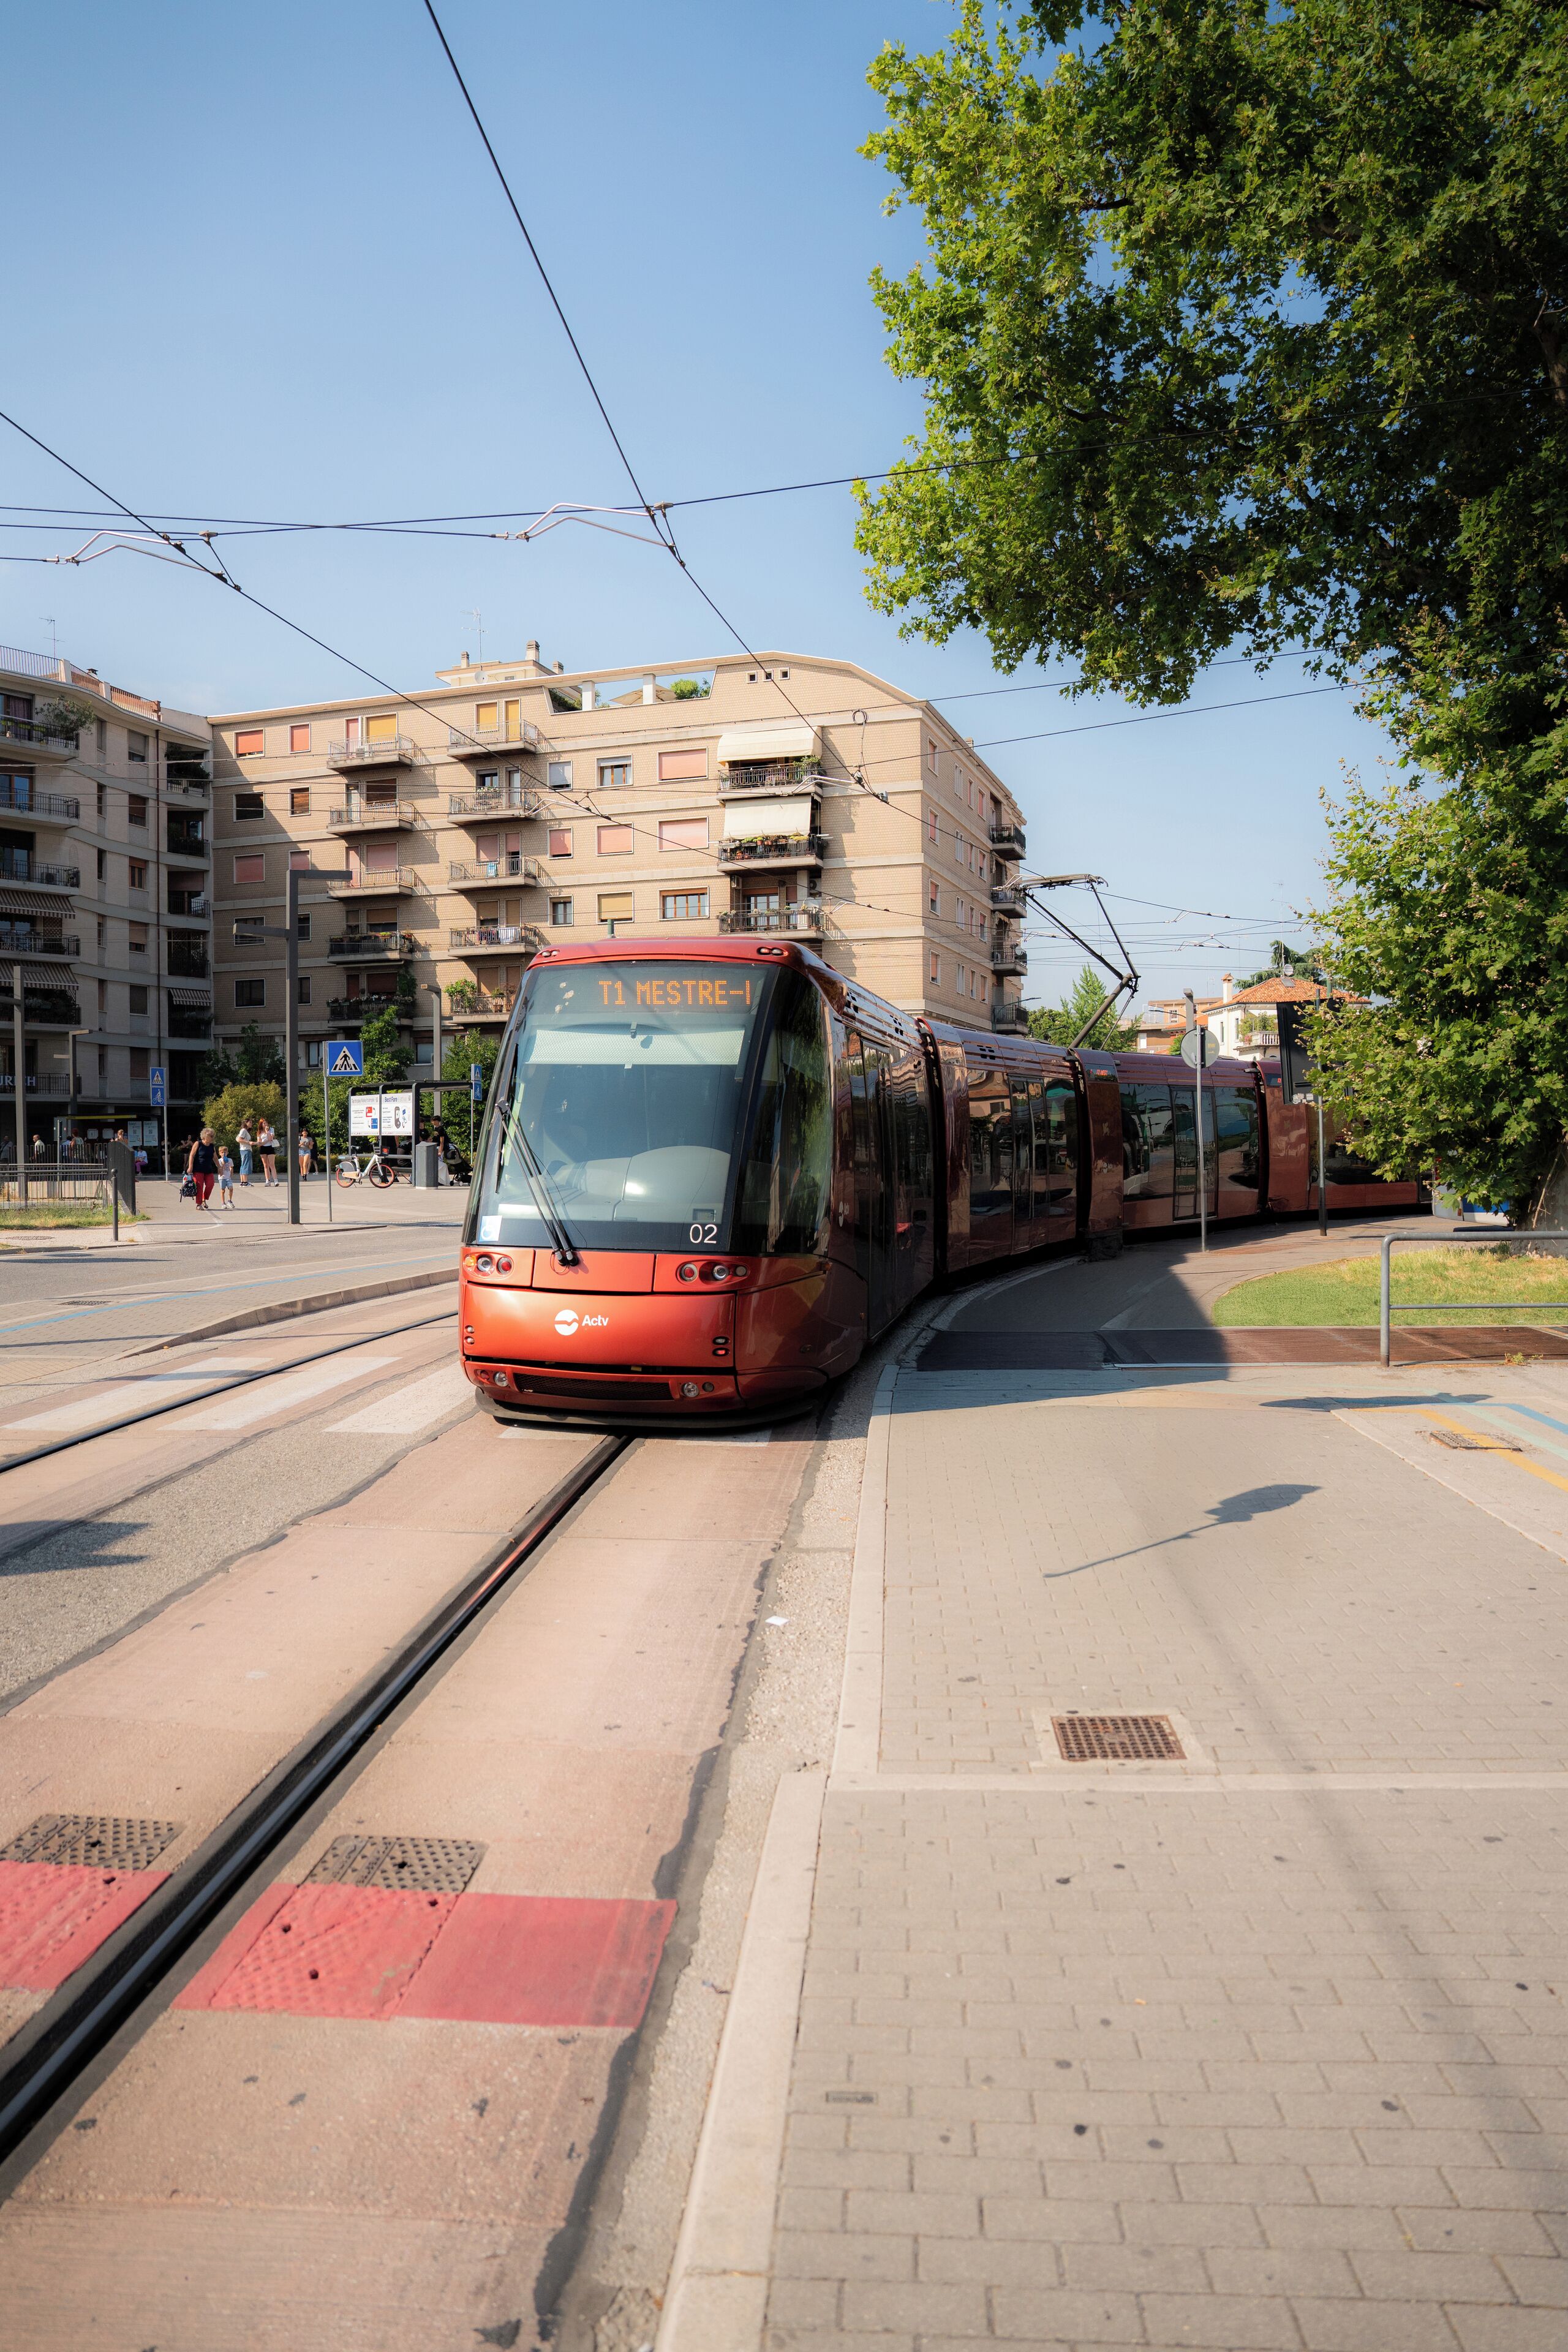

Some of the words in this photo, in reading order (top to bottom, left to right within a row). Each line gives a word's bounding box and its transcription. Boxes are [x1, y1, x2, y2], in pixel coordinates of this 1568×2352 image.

[598, 981, 625, 1005] T1
[690, 1224, 717, 1244] 02
[581, 1314, 609, 1327] Actv
